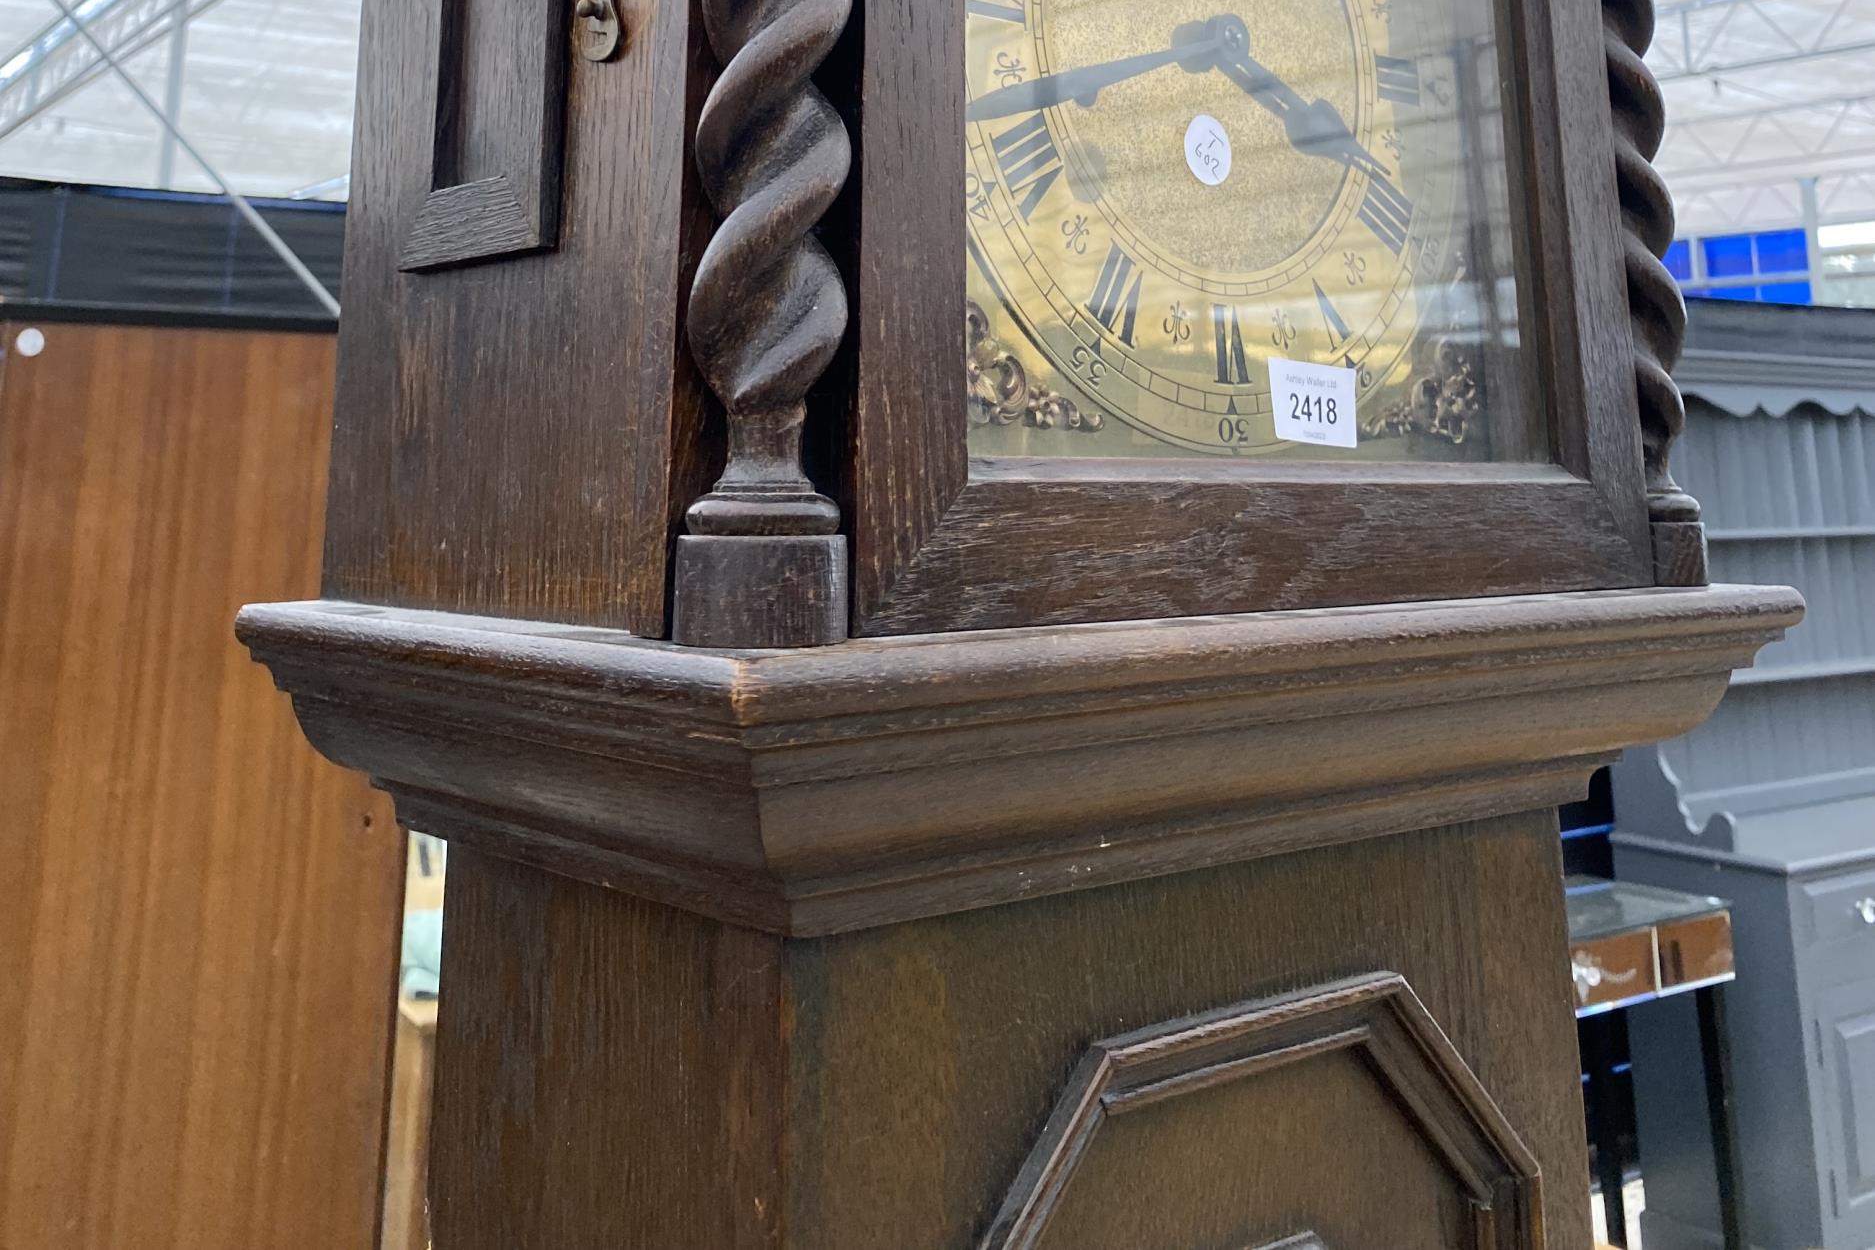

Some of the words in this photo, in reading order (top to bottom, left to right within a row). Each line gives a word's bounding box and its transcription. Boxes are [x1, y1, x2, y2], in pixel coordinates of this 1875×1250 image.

[966, 172, 993, 222] 40
[1084, 237, 1143, 350] VII
[1312, 277, 1354, 353] V
[1069, 346, 1107, 388] 35
[1211, 302, 1252, 385] VI
[1218, 417, 1249, 443] 30
[1289, 392, 1337, 425] 2418
